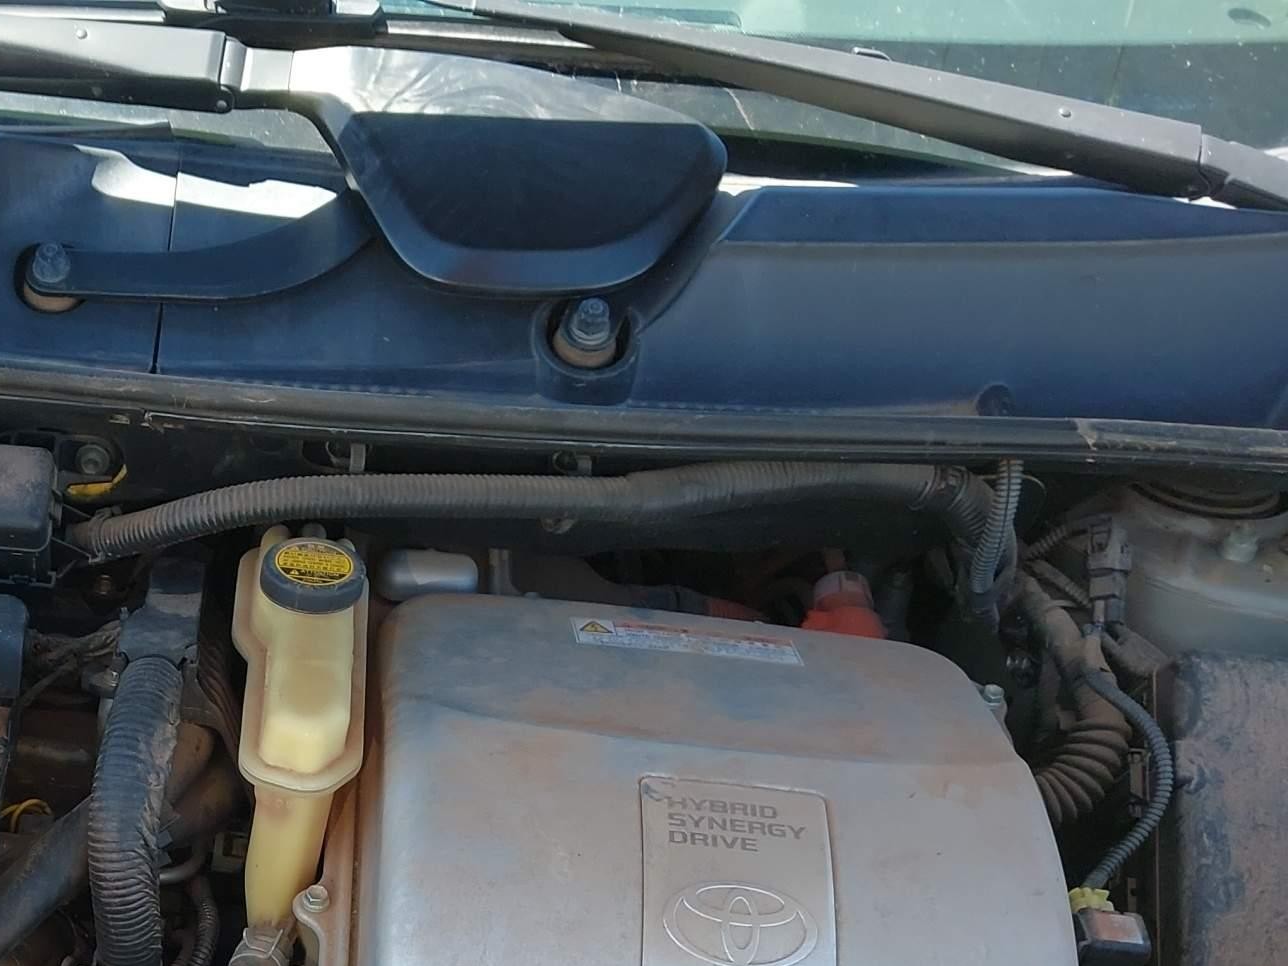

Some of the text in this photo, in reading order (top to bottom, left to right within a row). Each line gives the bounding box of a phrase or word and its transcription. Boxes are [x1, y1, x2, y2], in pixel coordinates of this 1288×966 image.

[667, 797, 778, 820] HYBRID
[667, 812, 807, 841] SYNERGY
[668, 830, 759, 852] DRIVE
